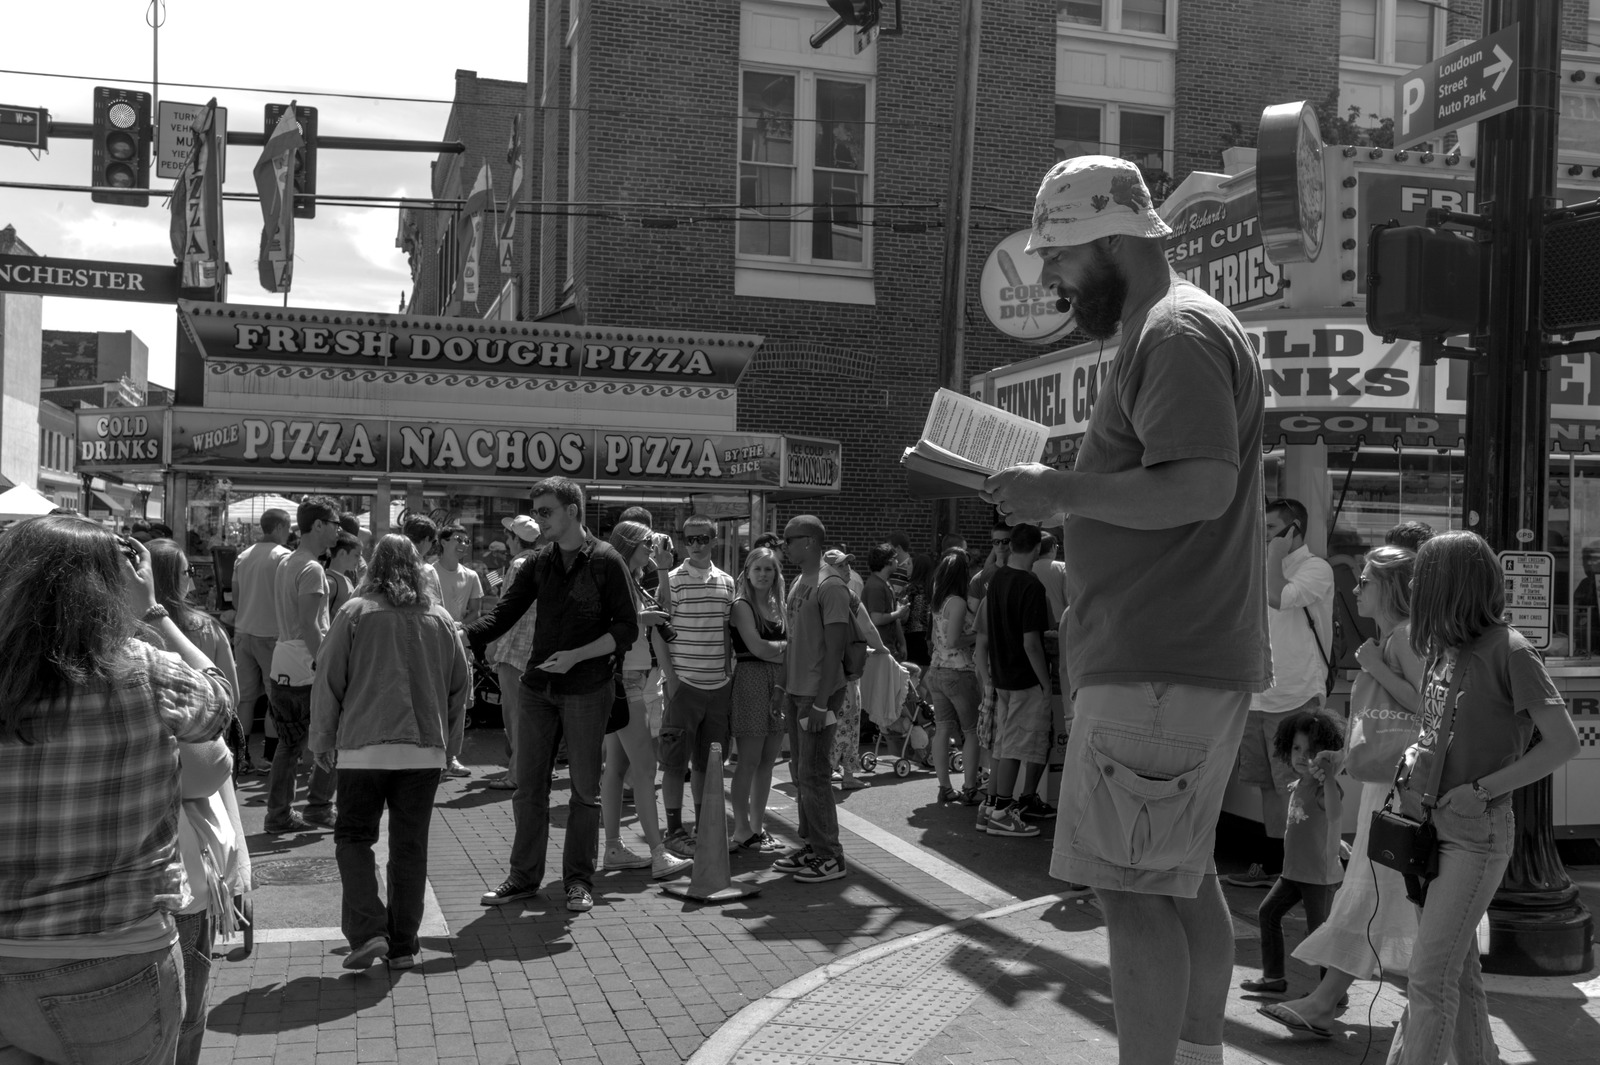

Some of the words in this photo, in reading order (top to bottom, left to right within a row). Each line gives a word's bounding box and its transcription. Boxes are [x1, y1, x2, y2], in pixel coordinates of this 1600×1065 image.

[1439, 49, 1483, 78] Loudoun
[1438, 77, 1468, 99] Street
[1401, 77, 1426, 136] P
[1438, 99, 1462, 120] Auto
[1463, 88, 1487, 112] Park
[1188, 203, 1227, 231] Richard's
[1210, 216, 1258, 248] CUT
[1208, 245, 1281, 307] FRIES
[1000, 300, 1060, 319] DOGS
[235, 323, 396, 358] FRESH
[409, 334, 571, 368] DOUGH
[585, 344, 713, 375] PIZZA
[998, 373, 1066, 427] FUNNEL
[97, 416, 148, 437] COLD
[1279, 416, 1439, 433] COLD
[82, 438, 158, 461] DRINKS
[192, 424, 239, 451] WHOLE
[243, 419, 376, 465] PIZZA
[400, 426, 584, 471] NACHOS
[605, 435, 722, 477] PIZZA
[724, 449, 739, 462] BY
[742, 445, 764, 459] THE
[791, 443, 802, 455] ICE
[804, 445, 824, 456] COLD
[730, 460, 761, 475] SLICE
[788, 454, 833, 486] LEMONADE
